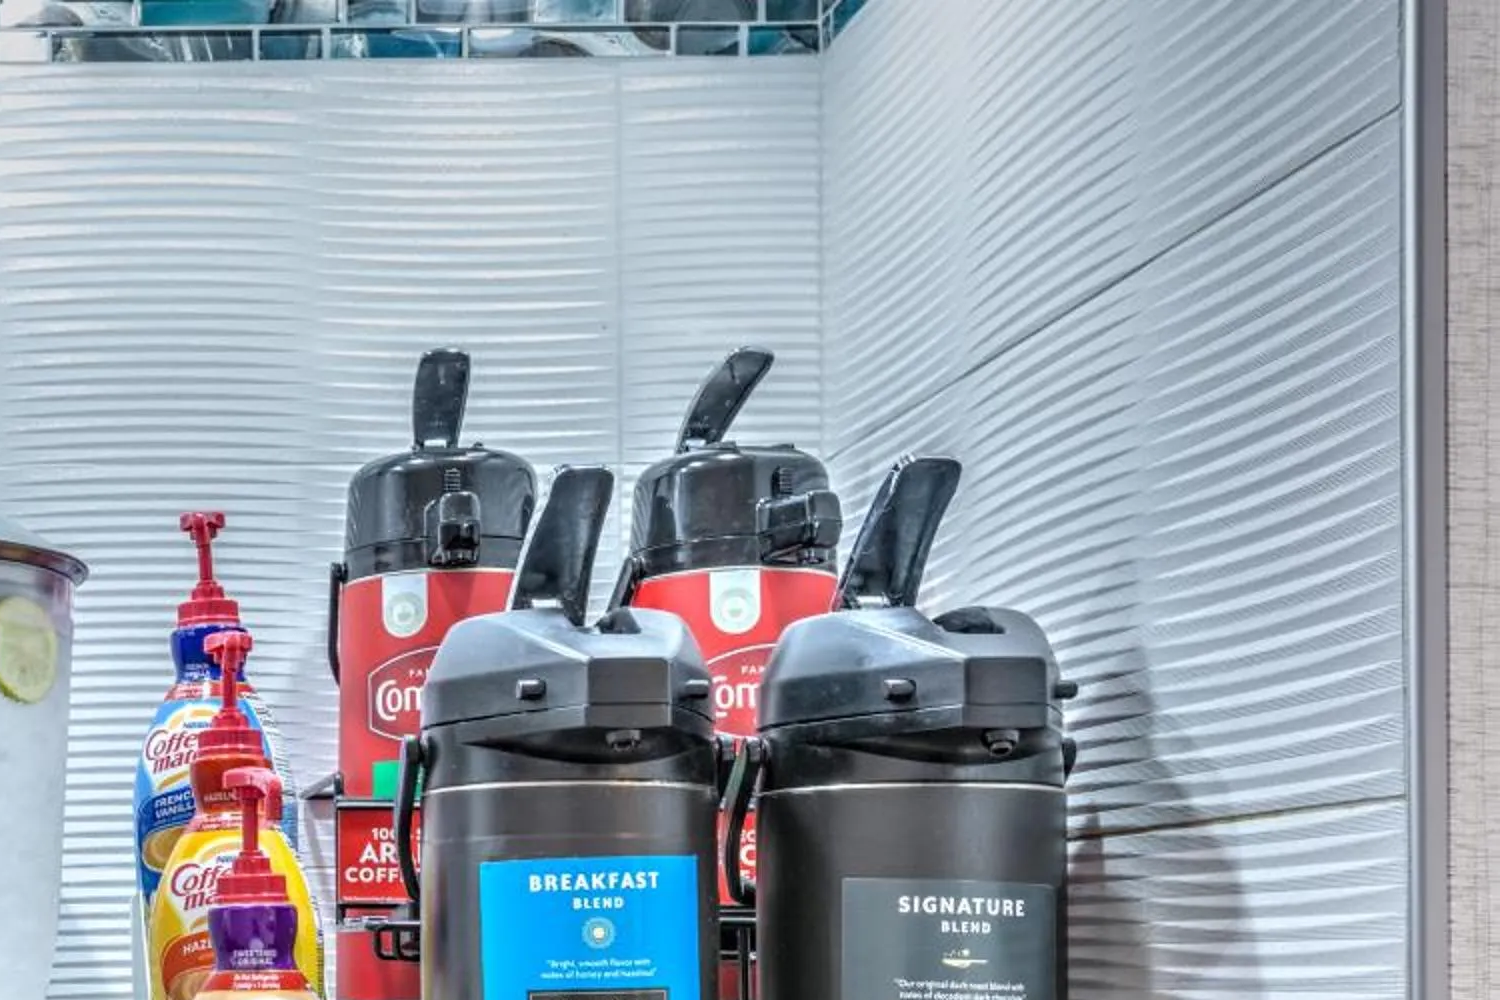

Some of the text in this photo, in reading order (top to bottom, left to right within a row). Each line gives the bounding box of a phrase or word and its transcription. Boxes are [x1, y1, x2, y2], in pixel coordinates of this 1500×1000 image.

[146, 728, 198, 761] Coffe
[155, 790, 192, 808] FRENC
[155, 803, 195, 819] VANILL
[171, 863, 231, 897] Coff
[344, 866, 403, 884] COFF
[528, 872, 660, 893] BREAKFAST
[572, 896, 625, 910] BLEND
[898, 895, 1026, 917] SIGNATURE
[941, 920, 992, 934] BLEND
